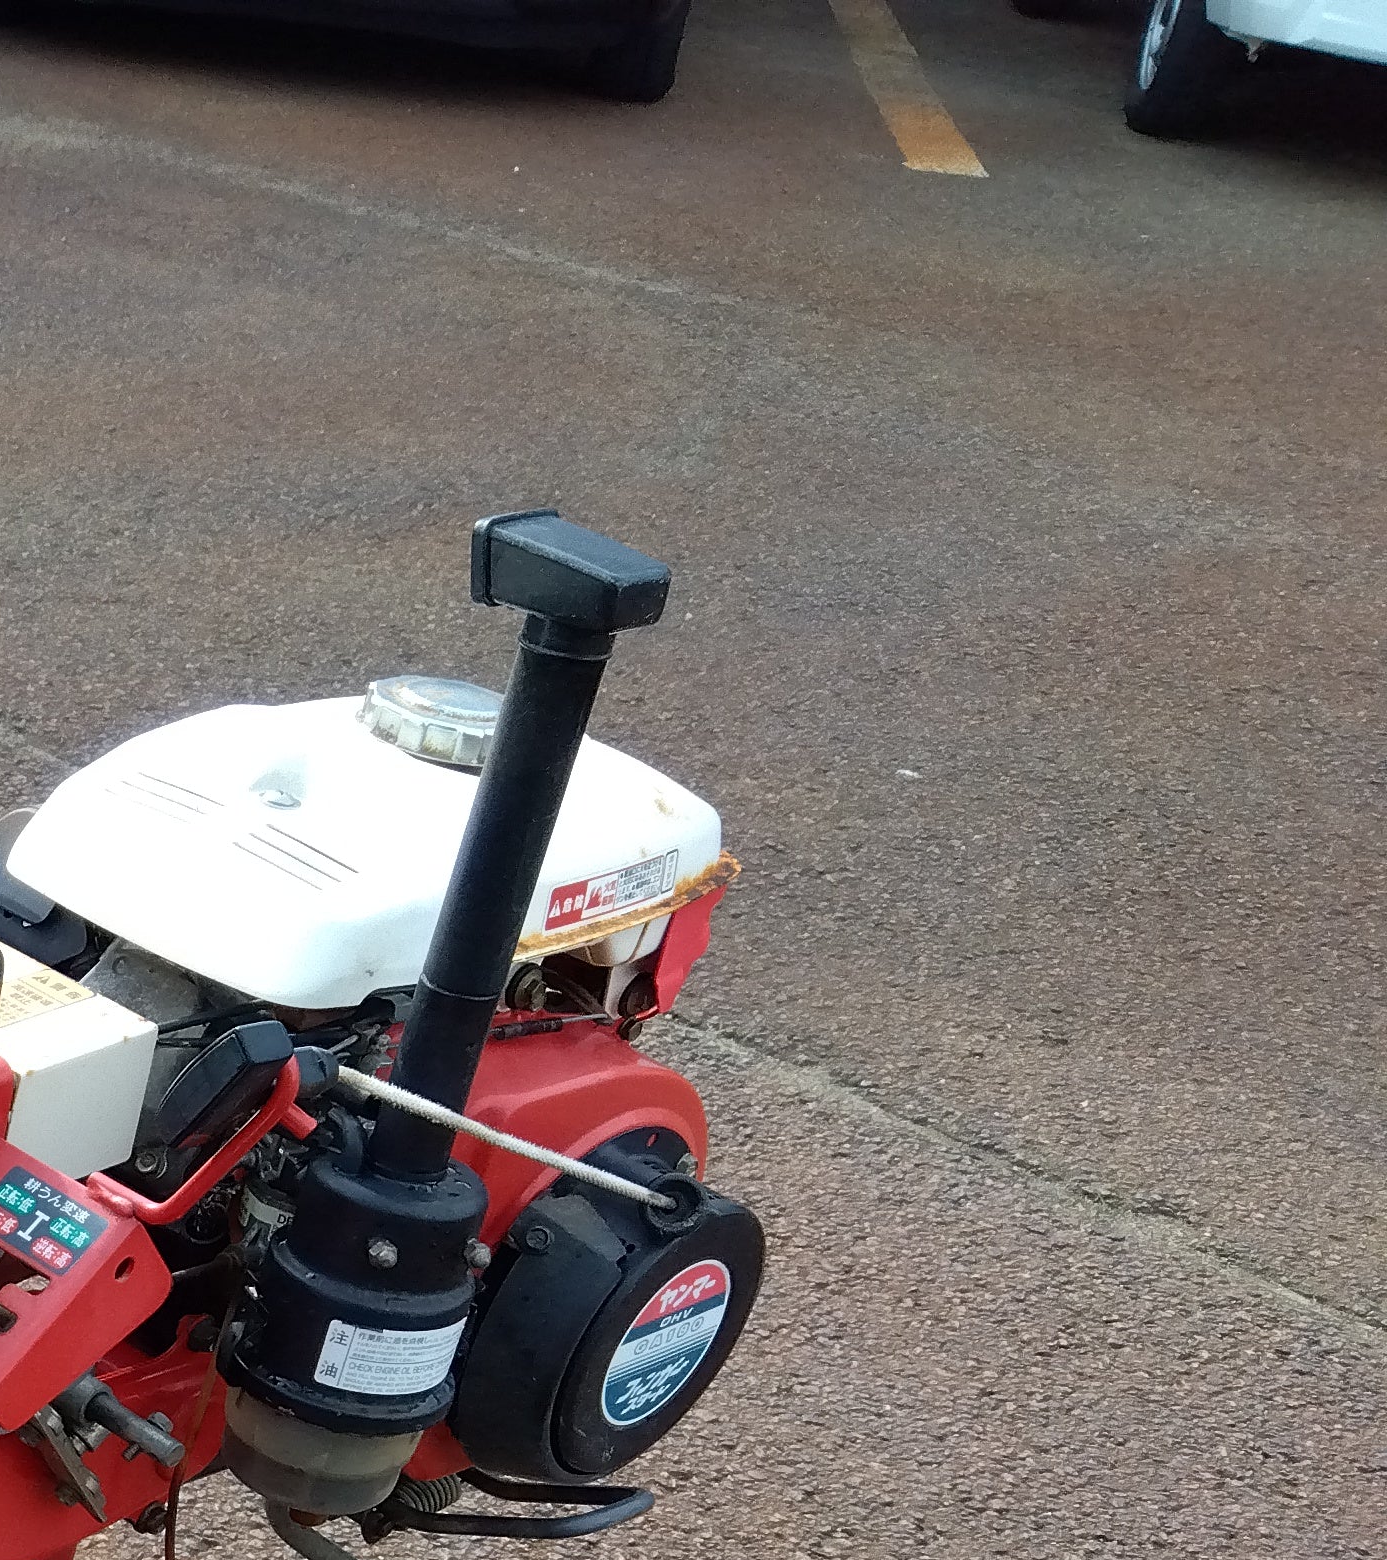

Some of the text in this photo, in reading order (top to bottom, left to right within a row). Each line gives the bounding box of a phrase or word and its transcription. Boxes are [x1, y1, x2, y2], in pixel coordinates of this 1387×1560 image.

[23, 1177, 90, 1225] 耕うん変速
[659, 1274, 716, 1314] ヤンマー
[634, 1316, 705, 1355] GA180
[660, 1307, 694, 1328] OHV
[348, 1361, 374, 1373] CHECK
[374, 1365, 401, 1375] ENGINE
